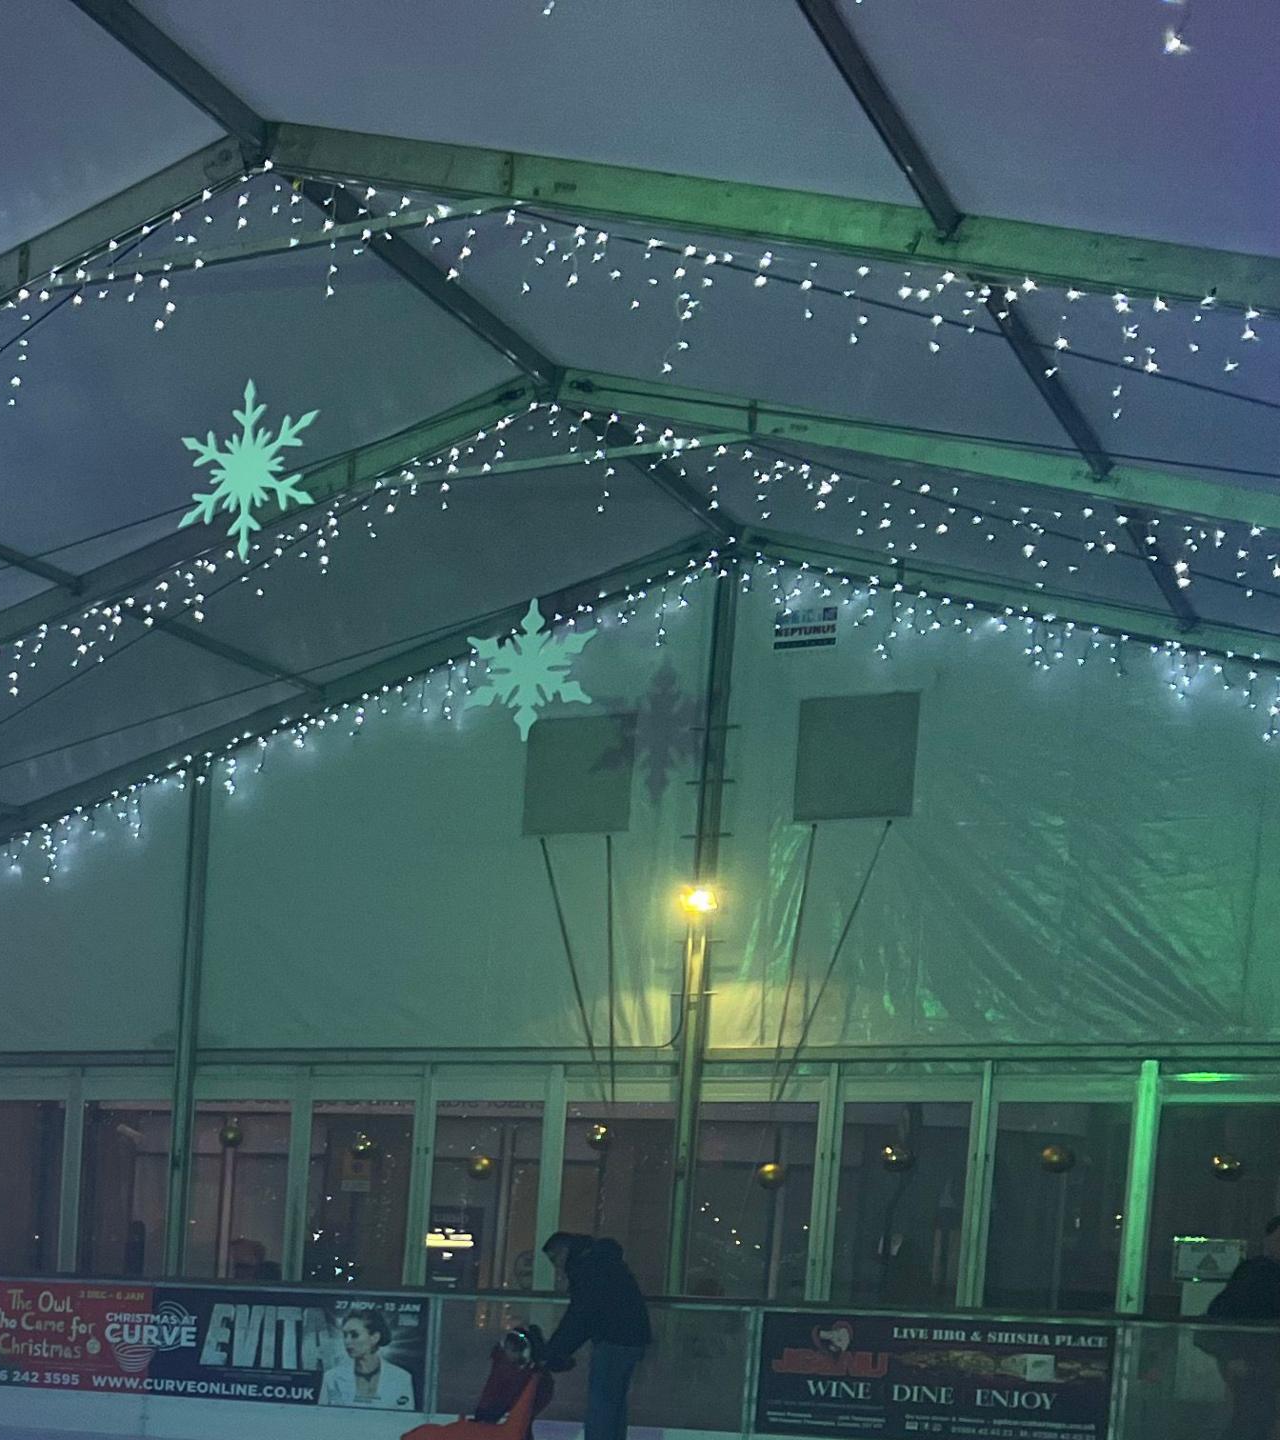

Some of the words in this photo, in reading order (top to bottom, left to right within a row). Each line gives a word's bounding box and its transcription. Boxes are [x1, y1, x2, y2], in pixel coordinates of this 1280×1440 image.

[7, 1288, 33, 1311] The
[124, 1292, 145, 1301] JAN
[350, 1301, 375, 1310] NOV
[398, 1303, 422, 1313] JAN
[21, 1311, 65, 1333] Came
[70, 1316, 96, 1342] for
[105, 1312, 177, 1326] CHRISTMAS
[180, 1312, 198, 1326] AT
[104, 1323, 198, 1347] CURVE
[199, 1303, 333, 1372] EVITA
[893, 1327, 928, 1340] LIVE
[932, 1329, 966, 1342] BBQ
[971, 1331, 982, 1342] &
[987, 1331, 1050, 1346] SHISHA
[1055, 1335, 1109, 1348] PLACE
[12, 1370, 39, 1383] 242
[43, 1372, 80, 1385] 3595
[92, 1375, 315, 1400] WWW.CURVEONLINE.CO.UK
[807, 1379, 872, 1399] WINE
[892, 1384, 955, 1404] DINE
[975, 1388, 1058, 1410] ENJOY
